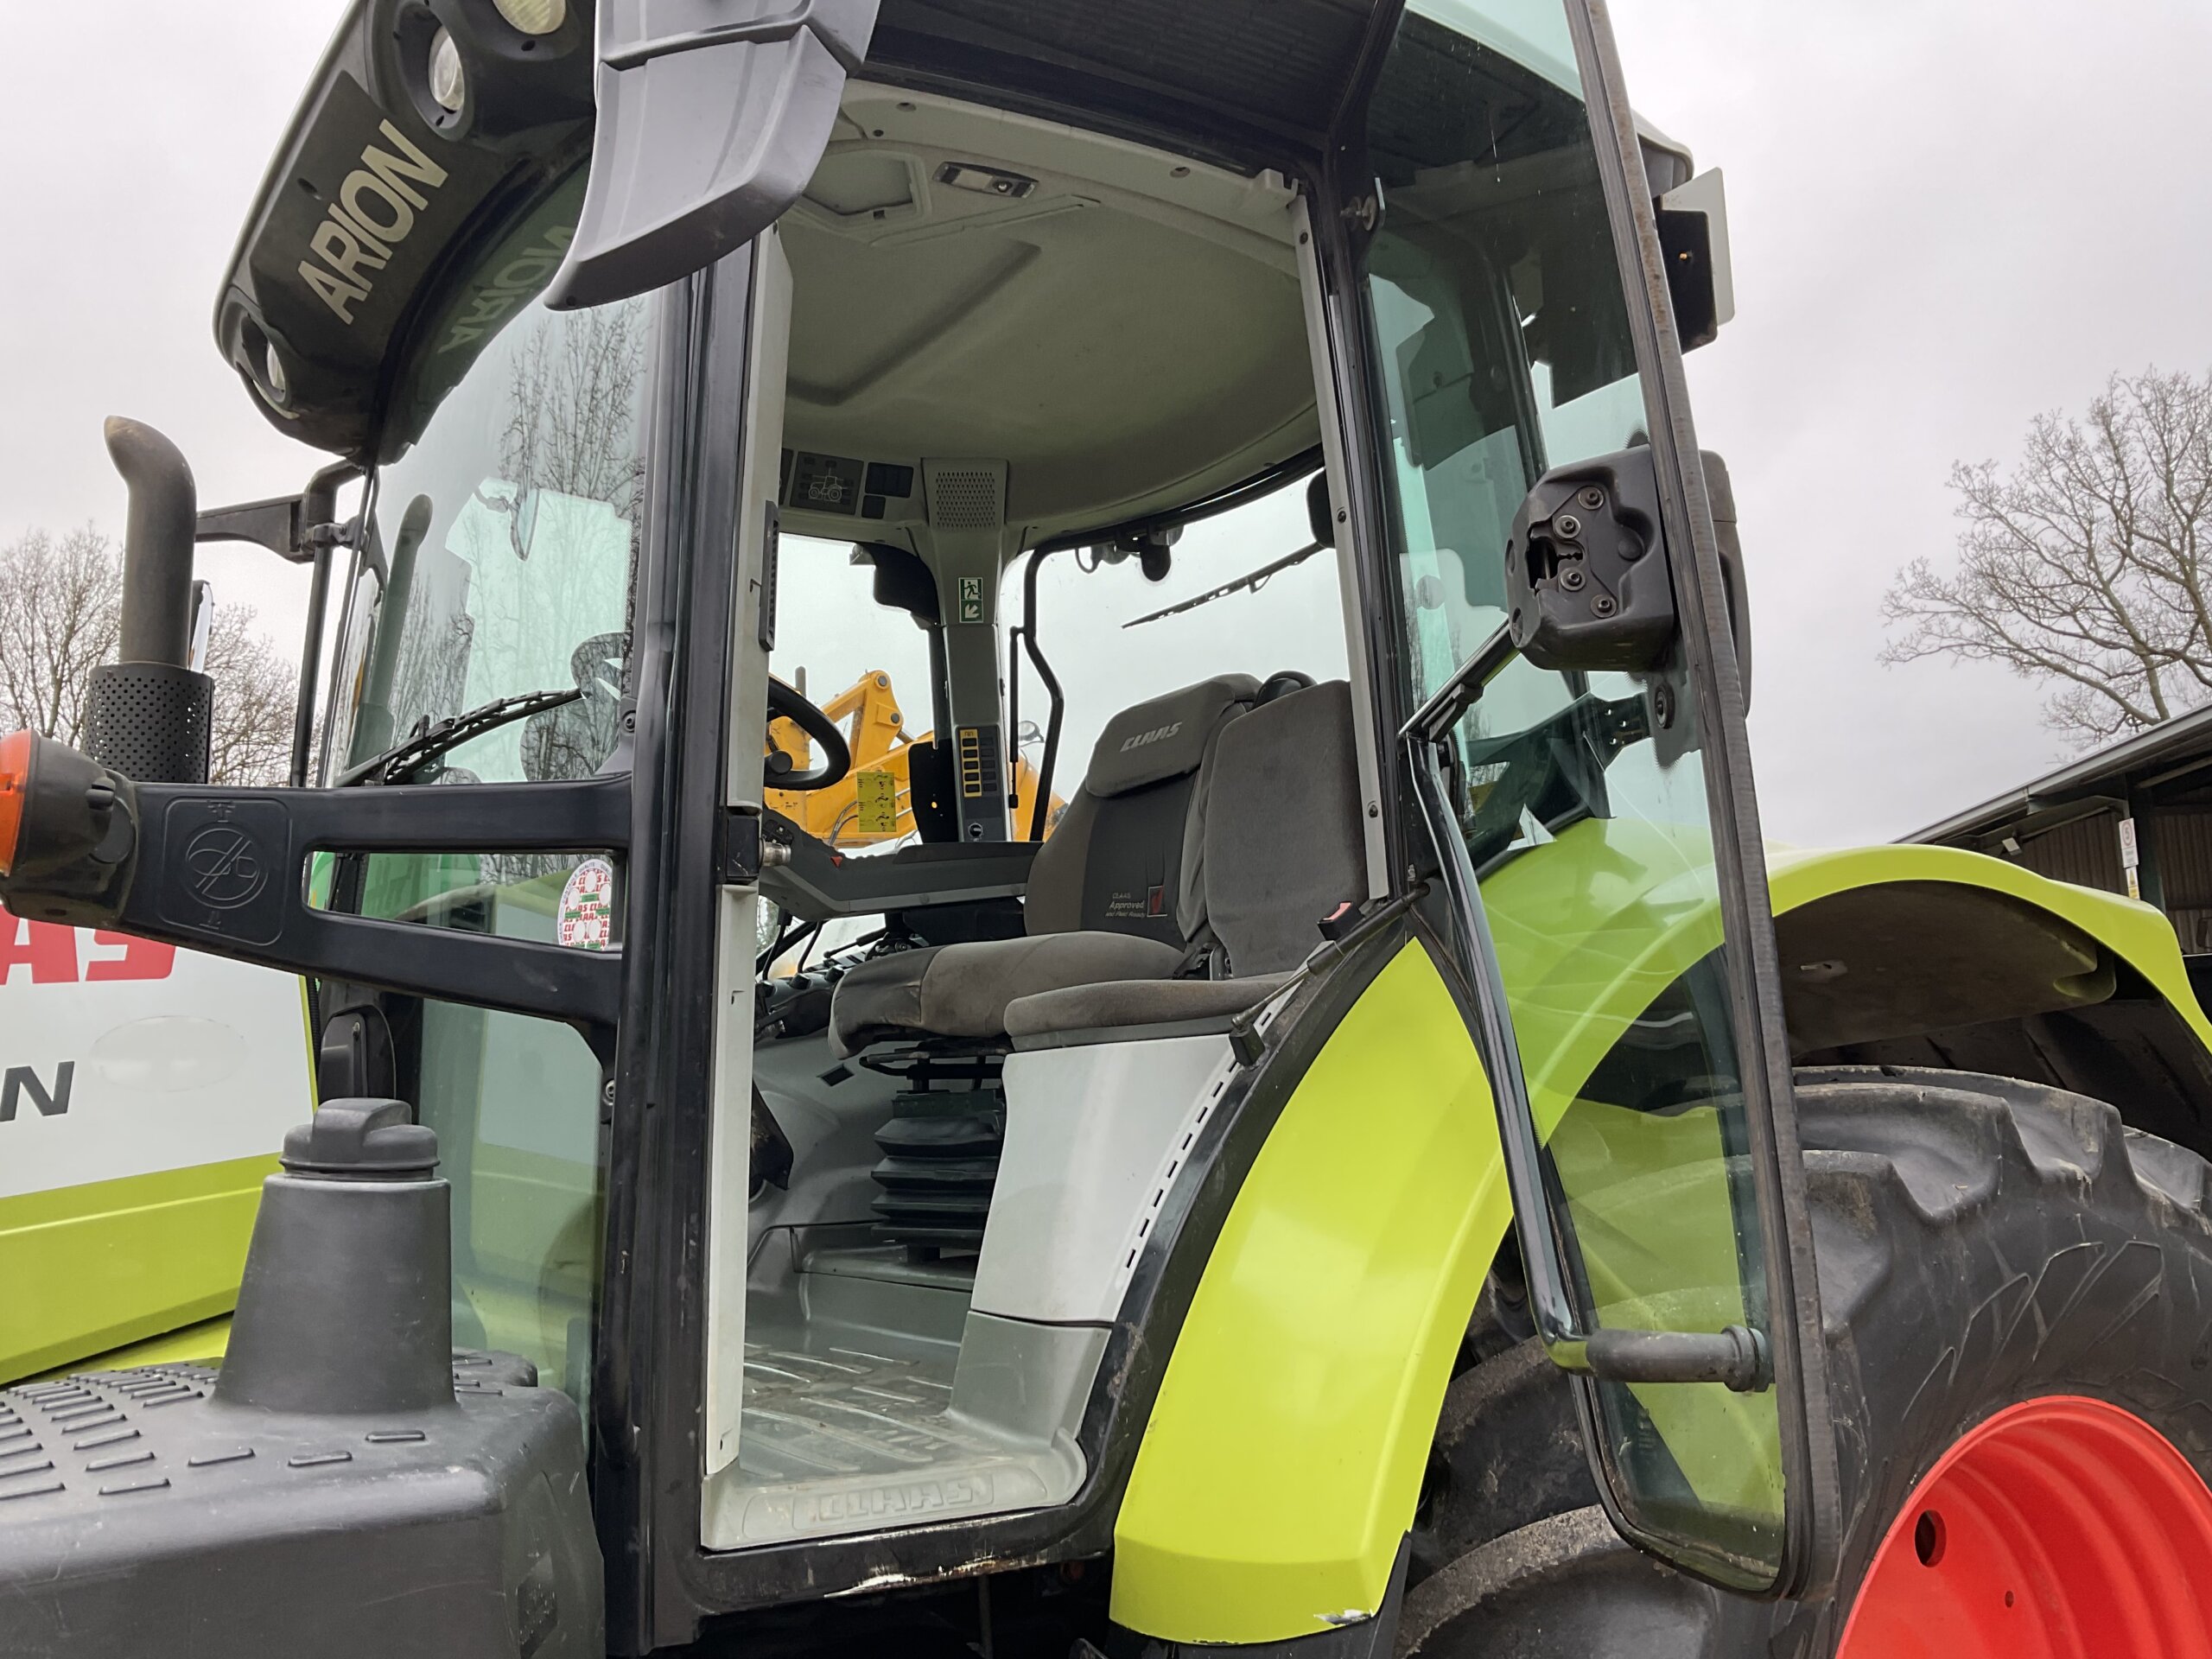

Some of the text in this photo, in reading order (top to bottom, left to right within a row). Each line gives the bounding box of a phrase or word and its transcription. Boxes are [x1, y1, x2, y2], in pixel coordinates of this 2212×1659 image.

[297, 119, 448, 325] ARION
[1120, 721, 1183, 753] CLAAS
[1109, 899, 1145, 910] Approved
[818, 1478, 974, 1522] CLAAS
